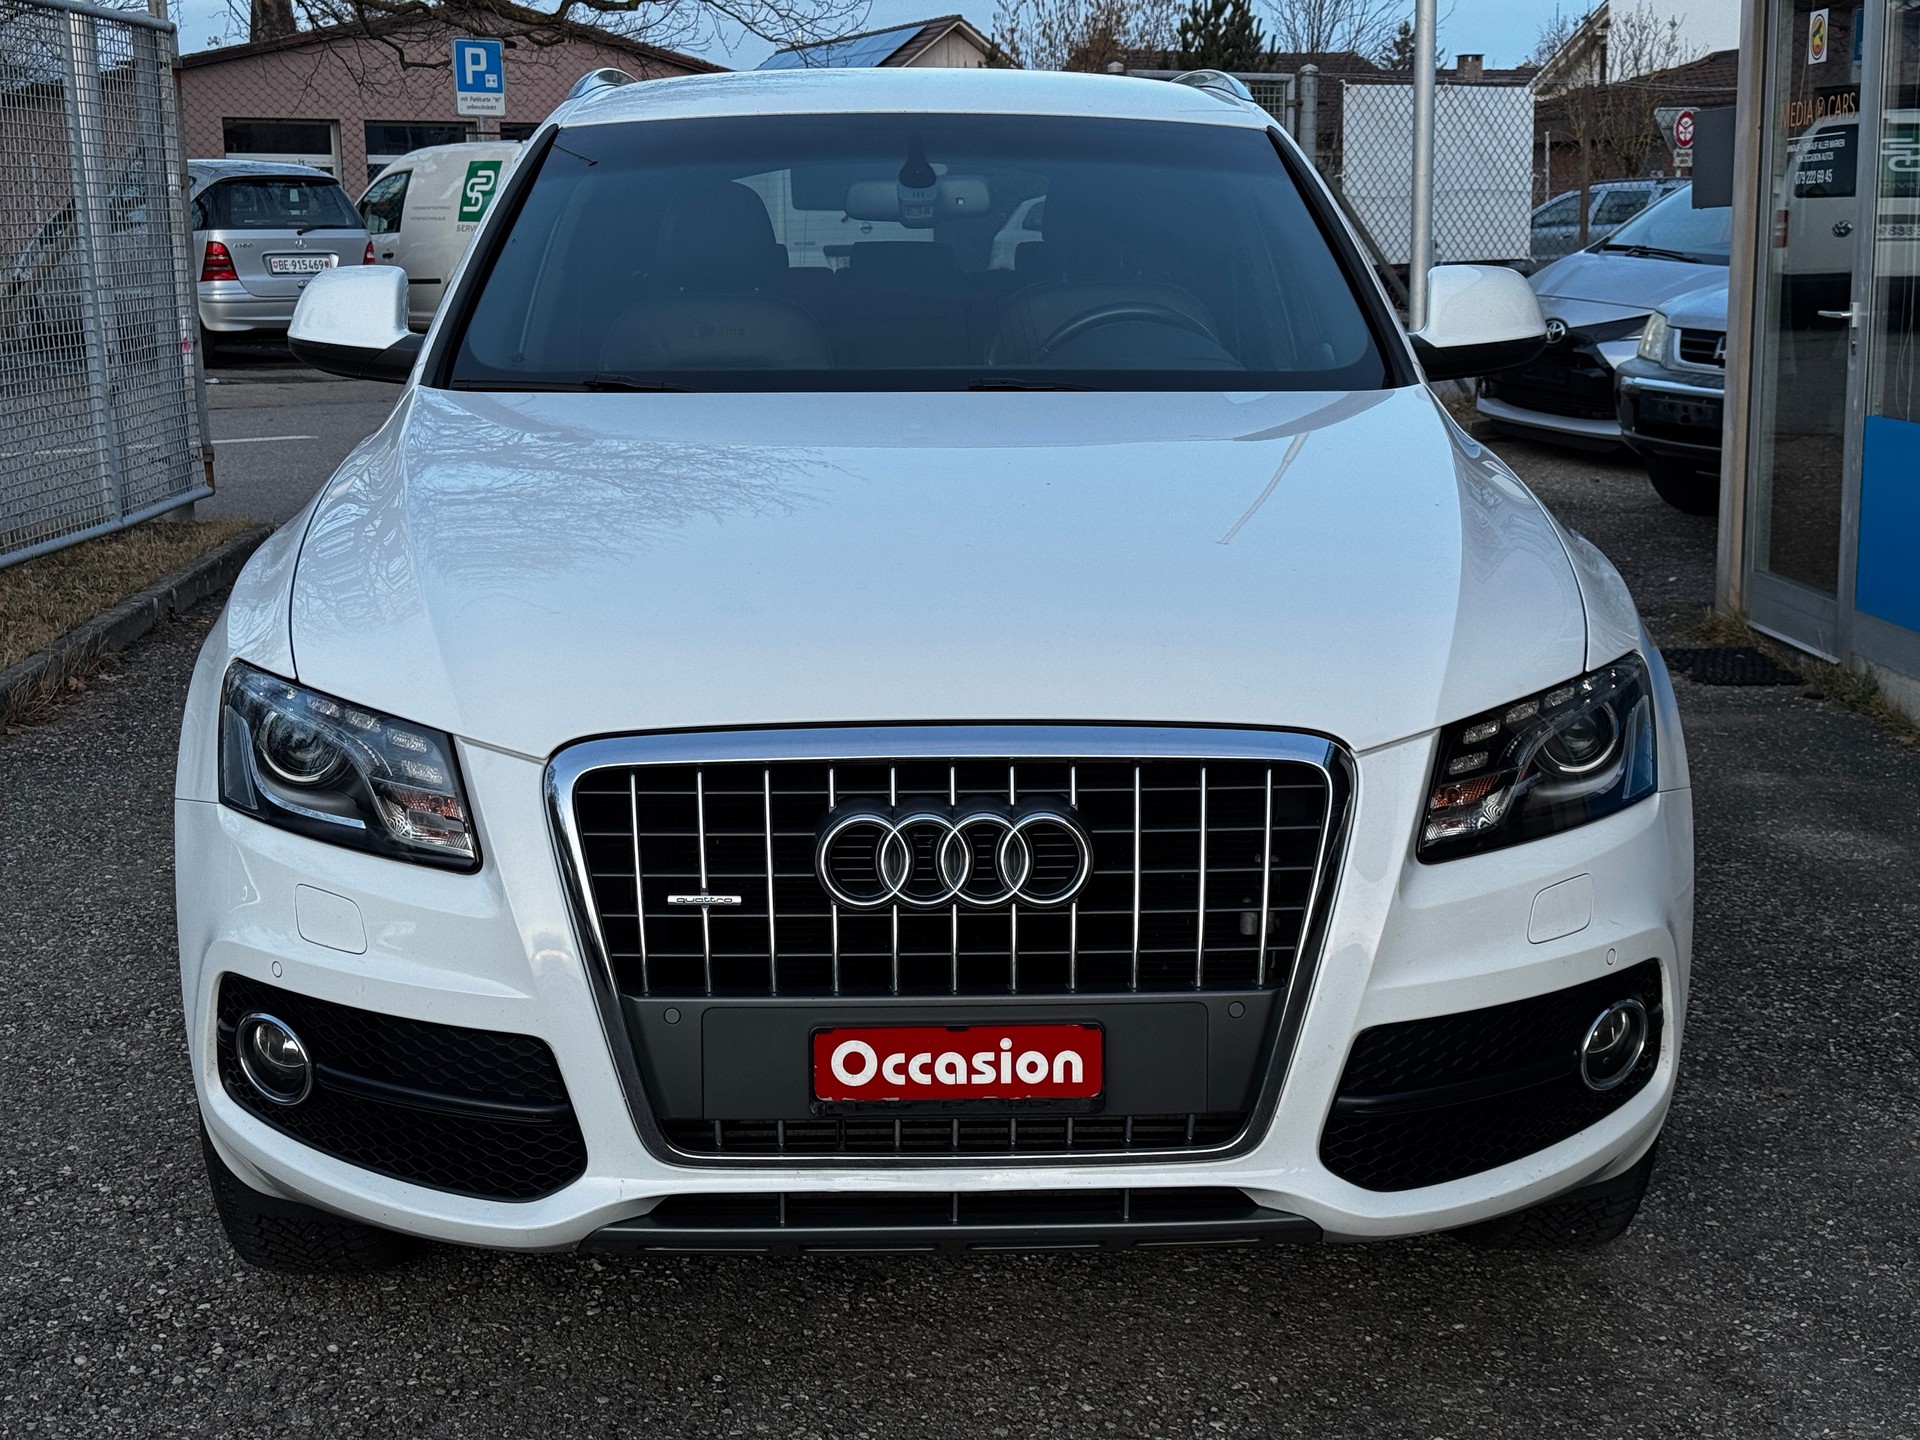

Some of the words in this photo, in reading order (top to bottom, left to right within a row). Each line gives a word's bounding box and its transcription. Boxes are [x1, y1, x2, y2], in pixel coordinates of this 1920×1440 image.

[465, 47, 487, 84] P
[1781, 100, 1813, 128] MEDIA
[1827, 92, 1856, 120] CARS
[1806, 170, 1817, 184] 222
[1825, 168, 1833, 183] 45
[831, 1037, 1084, 1087] Occasion
